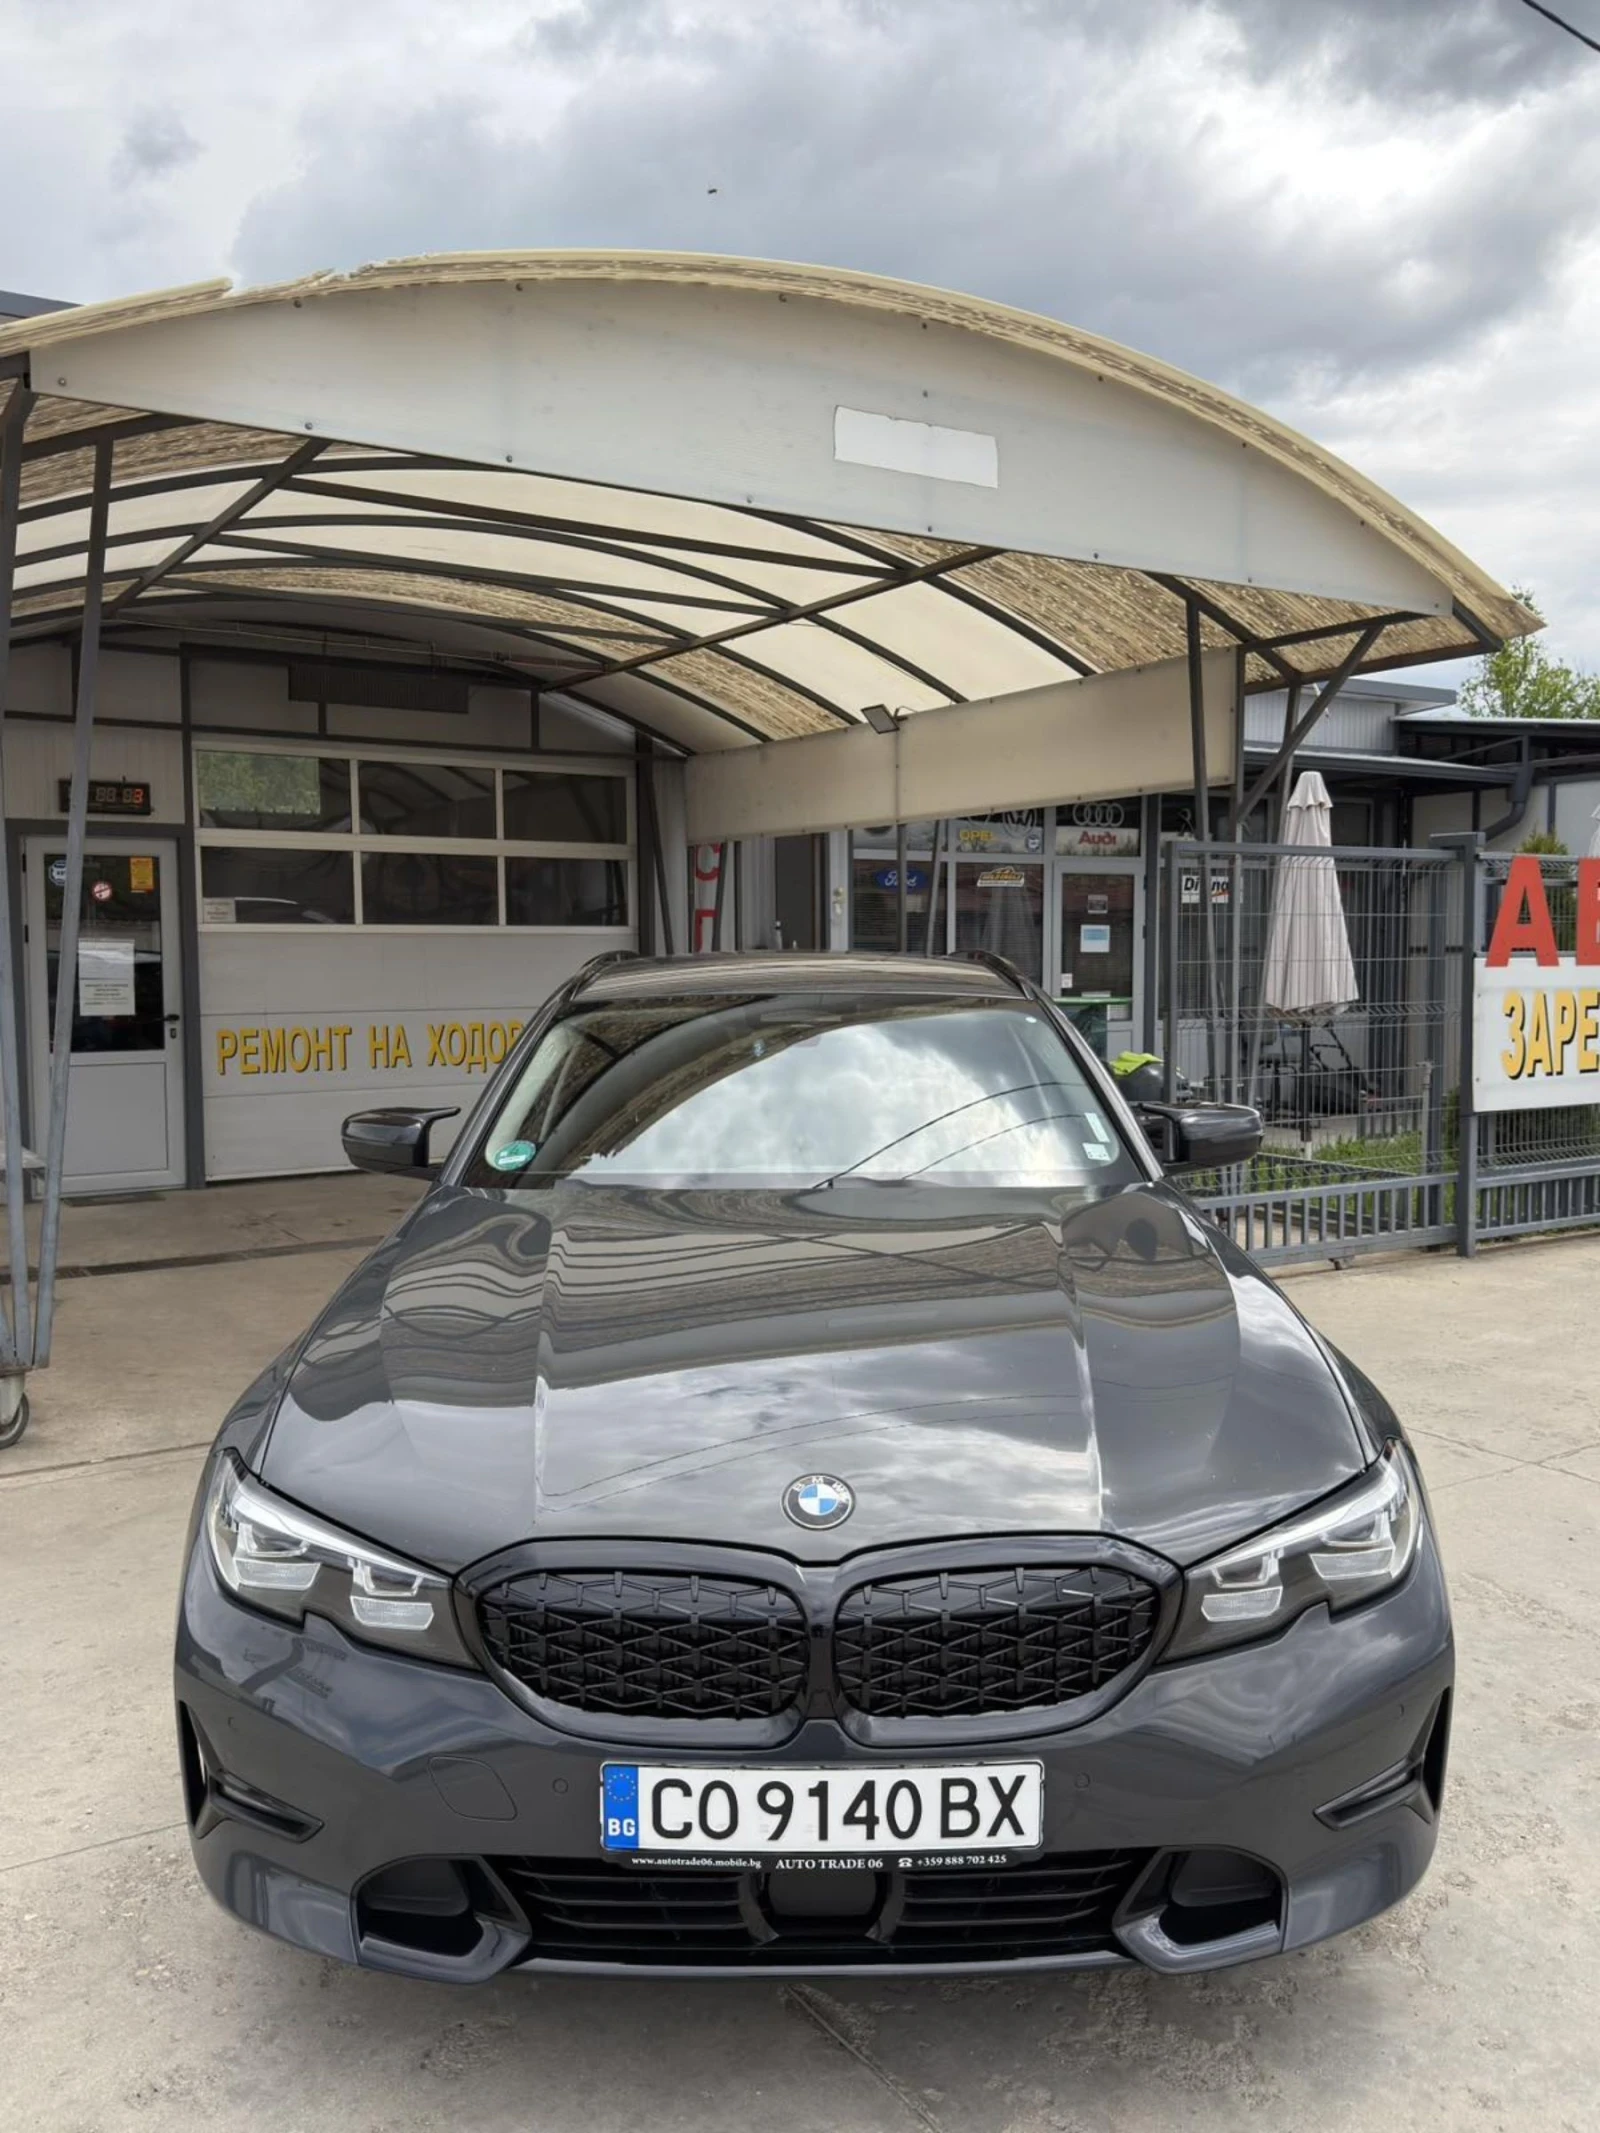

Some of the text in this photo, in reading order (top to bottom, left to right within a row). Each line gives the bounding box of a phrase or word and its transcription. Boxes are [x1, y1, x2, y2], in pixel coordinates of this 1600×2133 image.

[1079, 831, 1117, 846] Audi
[884, 870, 918, 888] Fd
[216, 1026, 353, 1075] РЕМОНТ
[369, 1023, 412, 1068] НА
[792, 1476, 850, 1504] BMW
[757, 1780, 922, 1841] 9140
[940, 1775, 1026, 1839] BX
[608, 1818, 636, 1836] BG
[631, 1853, 1008, 1870] www.autotrade06.mobile.bg AUTO TRADE 06 +359 888 702 425
